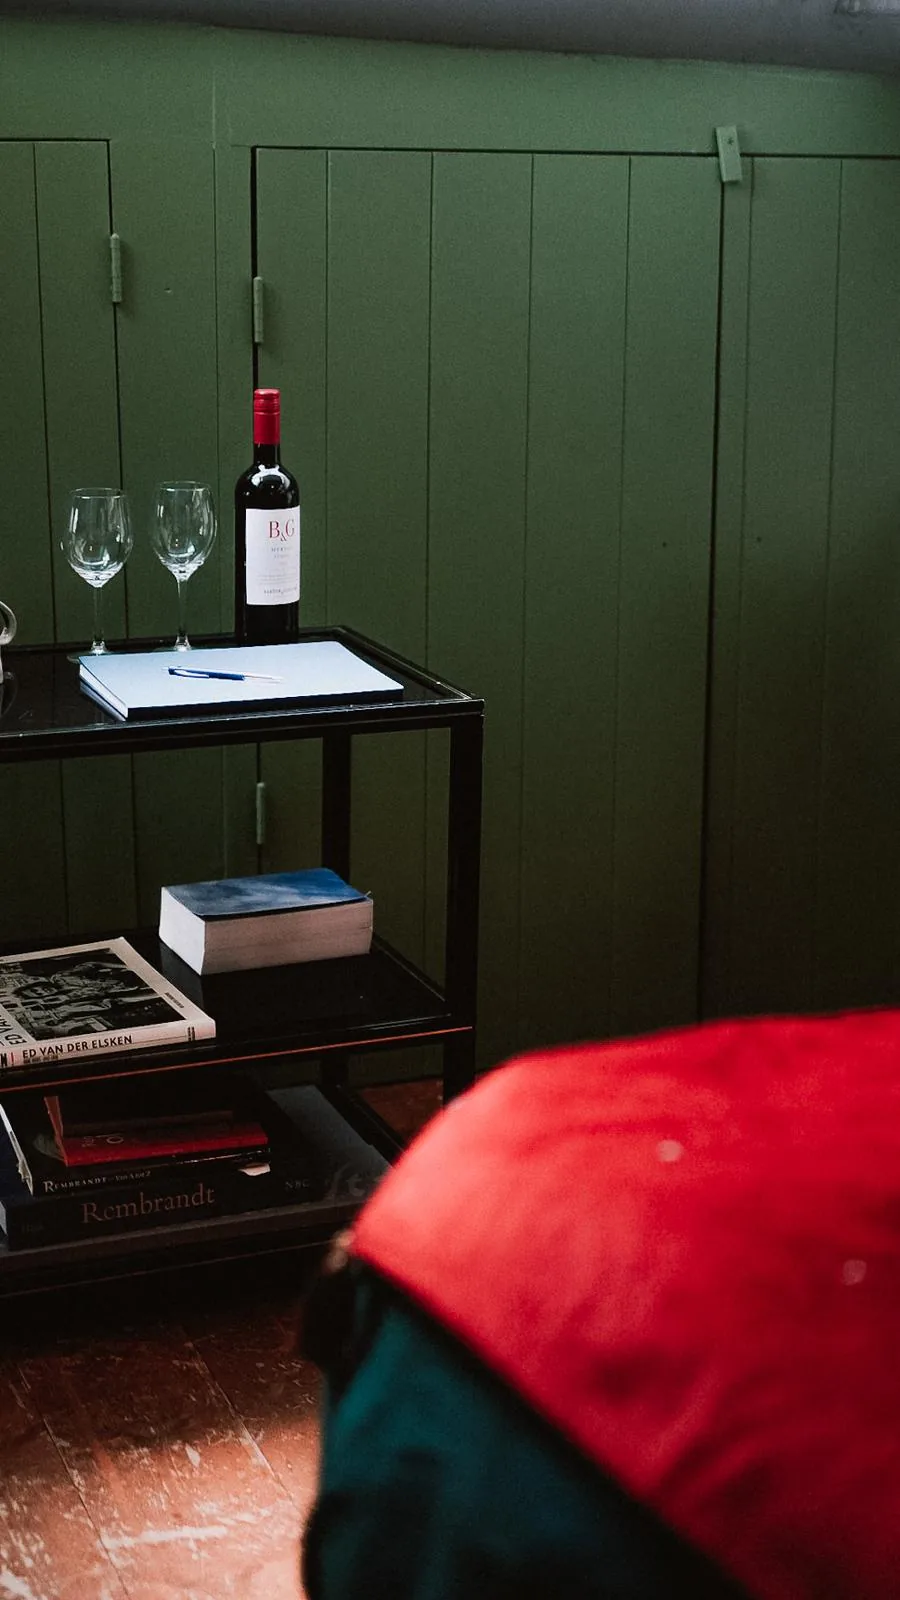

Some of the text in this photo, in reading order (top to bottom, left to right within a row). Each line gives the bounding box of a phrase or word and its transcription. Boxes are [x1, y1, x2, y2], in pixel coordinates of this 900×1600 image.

[269, 519, 295, 541] B&G
[22, 1035, 133, 1059] ED VAN DER ELSKEN
[81, 1182, 216, 1224] Rembrandt
